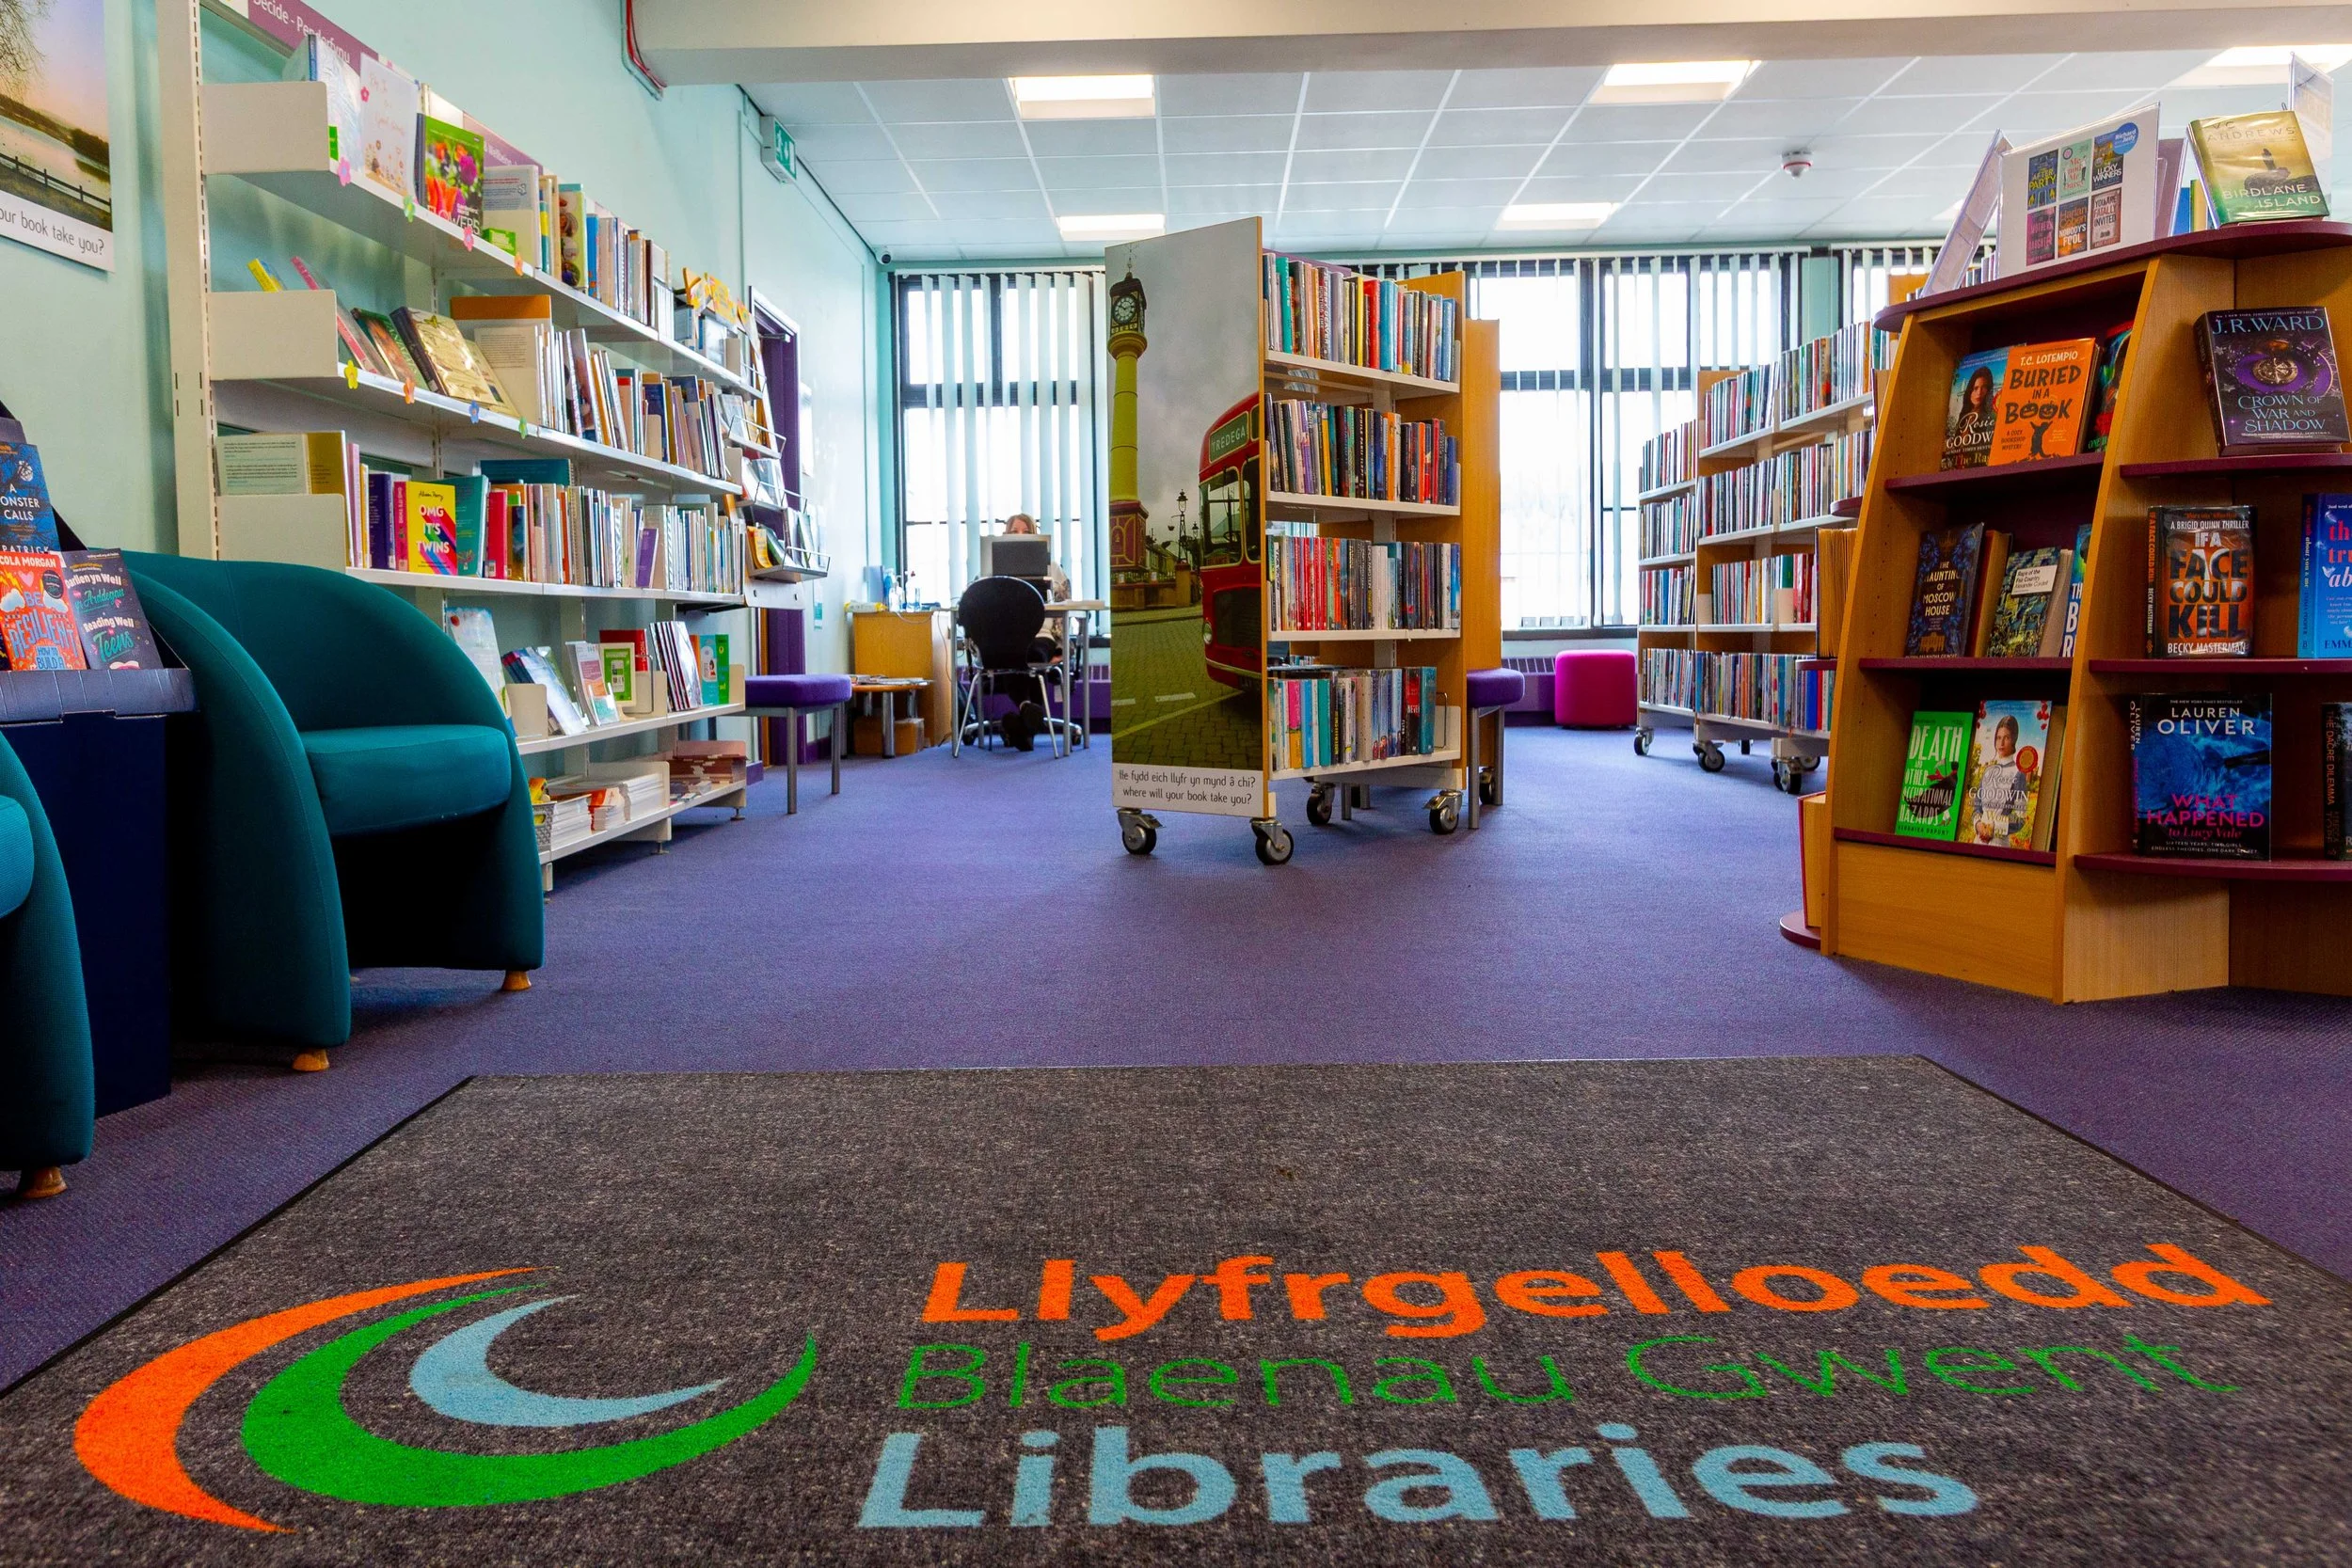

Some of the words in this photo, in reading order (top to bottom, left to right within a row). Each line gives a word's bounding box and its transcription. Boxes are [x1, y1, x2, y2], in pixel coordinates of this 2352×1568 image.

[2207, 126, 2296, 142] ANDREWS
[2032, 168, 2054, 181] AFTER
[2093, 168, 2122, 182] WINNERS
[2098, 163, 2118, 175] LUCKY
[2029, 174, 2057, 191] PARTY
[2222, 183, 2307, 199] BIRDLANE
[2258, 195, 2321, 208] ISLAND
[2094, 214, 2116, 227] INVITED
[21, 211, 48, 236] book
[53, 225, 74, 245] take
[78, 237, 104, 256] you?
[2063, 233, 2082, 247] FOOL
[2249, 315, 2325, 333] WARD
[2020, 356, 2034, 366] T.C.
[2036, 351, 2078, 365] LOTEMPIO
[2010, 365, 2081, 389] BURIED
[2032, 389, 2042, 399] IN
[2043, 388, 2050, 397] A
[2237, 395, 2304, 410] CROWN
[2307, 396, 2322, 404] OF
[2005, 398, 2073, 424] BOOK
[2252, 408, 2290, 420] WAR
[1958, 411, 1995, 434] Rosie
[2245, 419, 2326, 433] SHADOW
[1212, 425, 1246, 451] TREDEGA
[1946, 430, 1995, 449] GOODW
[9, 483, 17, 494] A
[0, 496, 40, 508] ONSTER
[4, 510, 34, 521] CALLS
[420, 504, 444, 517] OMG
[423, 522, 441, 534] IT'S
[2170, 521, 2175, 530] A
[2176, 520, 2199, 530] BRIGID
[2200, 520, 2220, 530] QUINN
[2222, 520, 2249, 530] THRILLER
[2195, 532, 2208, 547] IF
[2209, 532, 2221, 547] A
[2, 545, 50, 554] PATRICK
[417, 541, 450, 554] TWINS
[0, 556, 21, 566] COLA
[22, 557, 56, 568] MORGAN
[2169, 547, 2248, 580] FACE
[89, 573, 101, 585] yn
[101, 573, 121, 586] Well
[2024, 575, 2040, 583] Country
[1923, 592, 1956, 604] MOSCOW
[2072, 582, 2084, 599] TH
[2169, 580, 2248, 603] COULD
[24, 592, 44, 607] BE
[1925, 605, 1950, 616] HOUSE
[83, 616, 116, 633] Reading
[114, 616, 135, 627] Well
[2168, 604, 2247, 639] KILL
[8, 609, 78, 658] RESILIENT
[38, 647, 49, 657] HOW
[51, 647, 59, 657] TO
[93, 631, 135, 662] Teens
[2168, 642, 2194, 654] BECKY
[2196, 641, 2246, 654] MASTERMAN
[2324, 640, 2352, 649] EMM
[37, 657, 56, 669] BUILD
[2171, 707, 2240, 718] LAUREN
[2157, 719, 2255, 736] OLIVER
[1909, 725, 1963, 762] DEATH
[1131, 769, 1149, 783] fydd
[1152, 771, 1168, 783] eich
[1170, 772, 1186, 785] llyfr
[1190, 776, 1200, 786] yn
[1203, 776, 1226, 788] mynd
[1230, 776, 1234, 786] â
[1237, 776, 1256, 788] chi?
[1904, 768, 1928, 785] OTHER
[1986, 766, 2017, 788] Rosie
[2327, 765, 2335, 805] DILEMMA
[1123, 787, 1147, 798] where
[1150, 788, 1163, 799] will
[1166, 790, 1184, 801] your
[1187, 790, 1207, 801] book
[1210, 792, 1228, 803] take
[1231, 793, 1252, 806] you?
[1902, 786, 1952, 806] OCCUPATIONAL
[1968, 787, 2030, 802] GOODWIN
[2171, 794, 2238, 809] WHAT
[1899, 803, 1940, 826] HAZARDS
[2146, 810, 2265, 828] HAPPENED
[2169, 828, 2180, 836] to
[2183, 828, 2213, 840] Lucy
[2216, 828, 2242, 839] Vale
[923, 1244, 2270, 1341] Llyfrgelloedd
[898, 1338, 1575, 1409] Blaenau
[1625, 1335, 2237, 1400] Gwent
[862, 1425, 1978, 1527] Libraries
